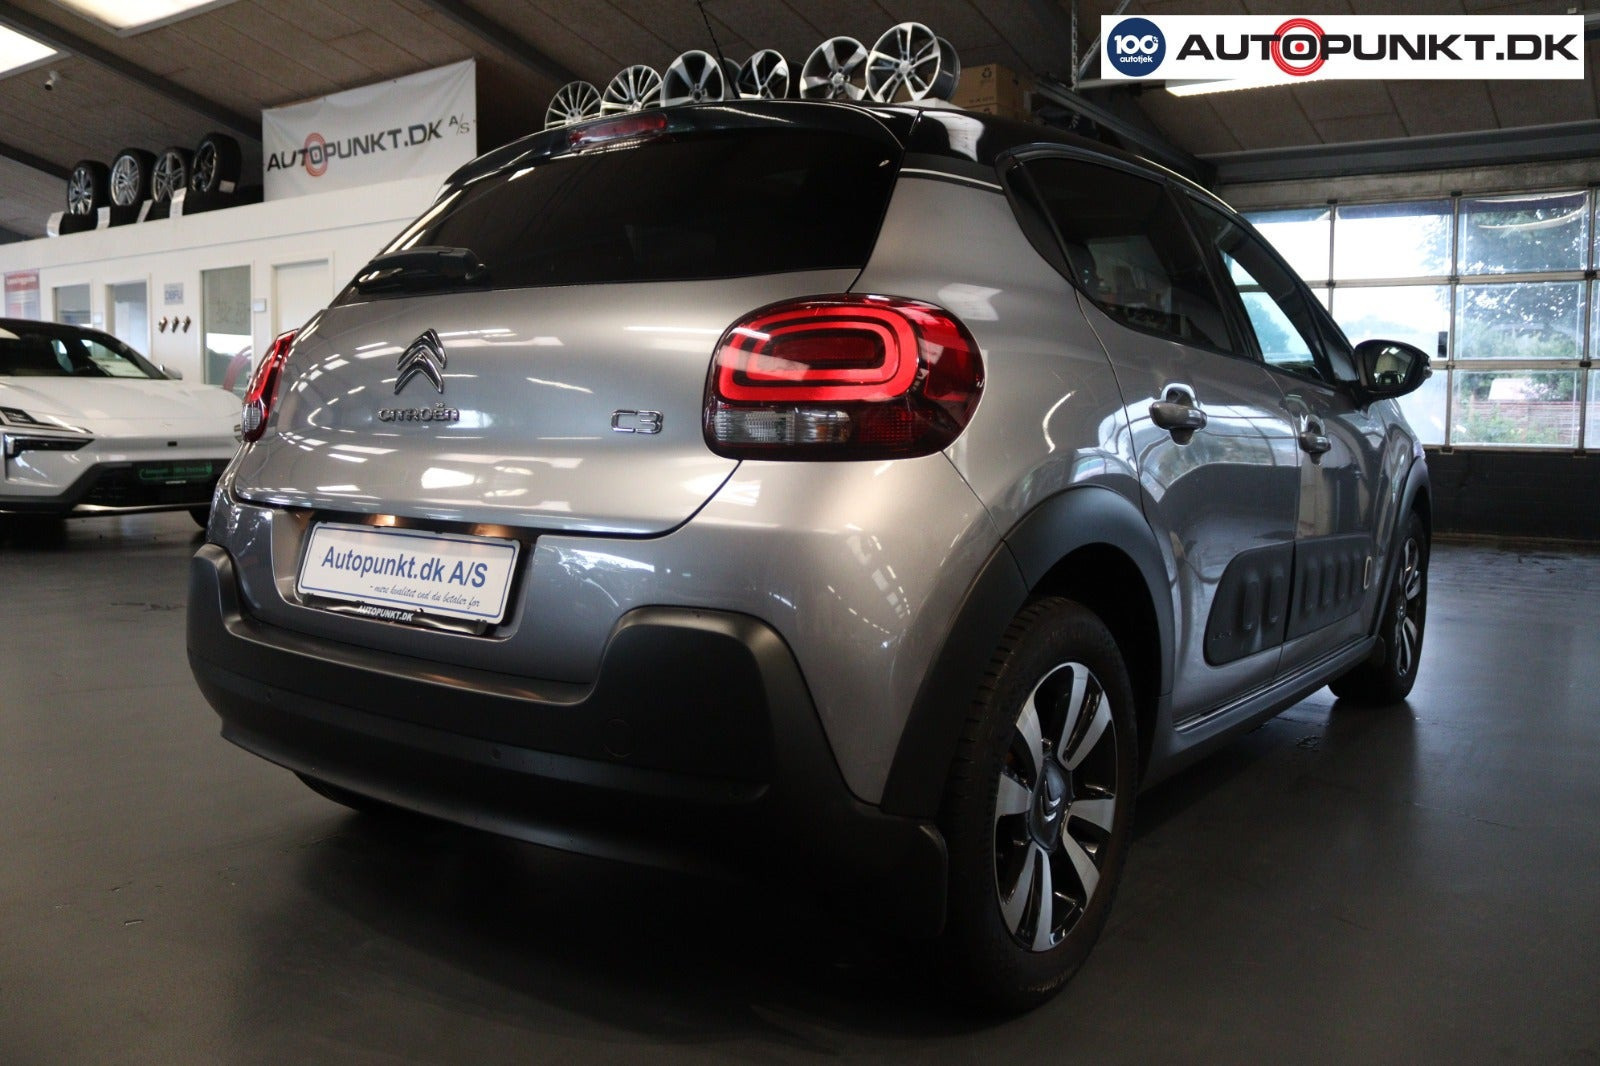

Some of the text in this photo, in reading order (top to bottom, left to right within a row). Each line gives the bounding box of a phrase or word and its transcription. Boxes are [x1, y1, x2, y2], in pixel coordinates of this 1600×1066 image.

[266, 113, 470, 172] AUTOPUNKT.DK A/S
[611, 409, 664, 434] C3
[321, 546, 488, 588] Autopunkt.dk A/S
[357, 604, 414, 622] AUTOPUNKT.DK
